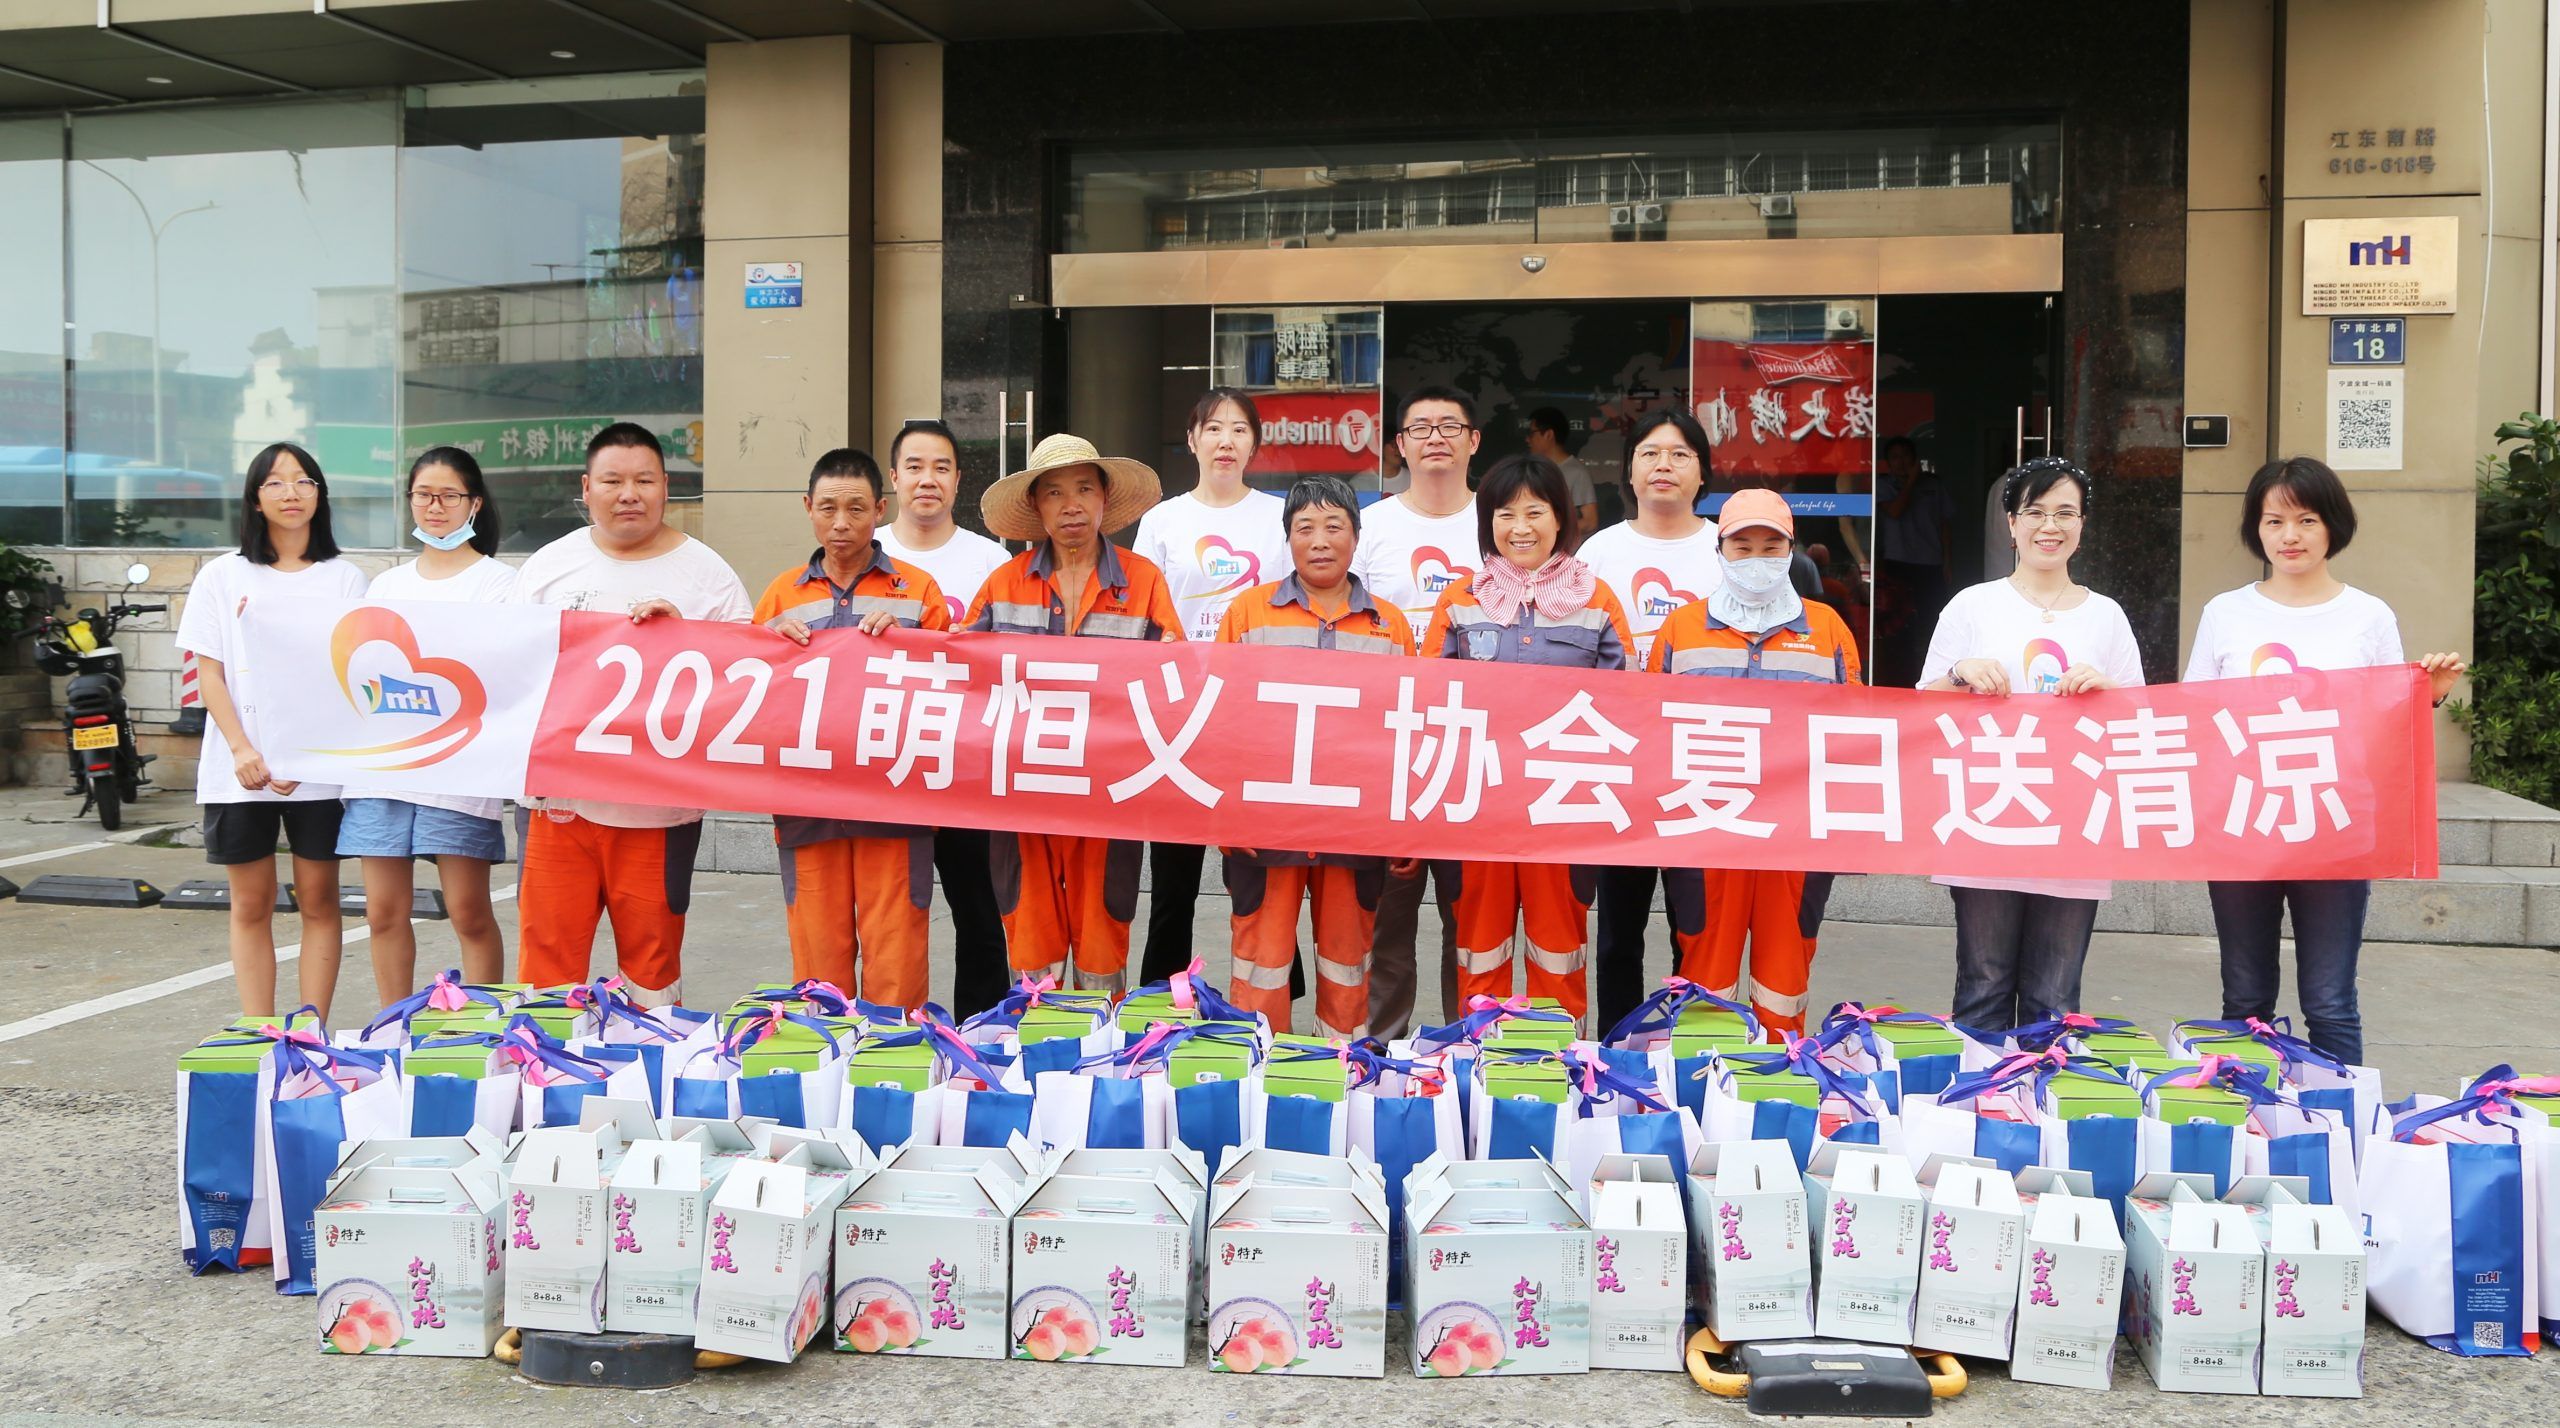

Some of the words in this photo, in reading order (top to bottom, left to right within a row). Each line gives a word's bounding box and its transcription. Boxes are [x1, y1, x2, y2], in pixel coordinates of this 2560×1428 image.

[2330, 127, 2436, 148] 江东南路
[2329, 155, 2436, 174] 616-618号
[2340, 323, 2397, 333] 宁南北路
[2353, 338, 2385, 359] 18
[1822, 501, 1836, 509] life
[575, 643, 2353, 851] 2021萌恒义工协会夏日送清凉
[512, 1189, 540, 1250] 水蜜桃
[613, 1192, 642, 1253] 水蜜桃
[1832, 1196, 1860, 1259] 水蜜桃
[341, 1228, 366, 1241] 特产
[862, 1228, 887, 1241] 特产
[1719, 1201, 1751, 1261] 水蜜桃
[1929, 1210, 1958, 1272] 水蜜桃
[710, 1211, 739, 1274] 水蜜桃
[1040, 1236, 1066, 1249] 特产
[1237, 1247, 1263, 1260] 特产
[1446, 1251, 1471, 1264] 特产
[1596, 1234, 1625, 1292] 水蜜桃
[2030, 1247, 2059, 1307] 水蜜桃
[2172, 1257, 2202, 1316] 水蜜桃
[408, 1256, 446, 1329] 水蜜桃
[533, 1292, 562, 1302] 8+8+8
[928, 1257, 965, 1330] 水蜜桃
[2274, 1258, 2305, 1318] 水蜜桃
[635, 1295, 664, 1305] 8+8+8
[1108, 1265, 1144, 1338] 水蜜桃
[1748, 1302, 1777, 1311] 8+8+8
[1850, 1301, 1879, 1312] 8+8+8
[727, 1316, 756, 1328] 8+8+8
[1306, 1275, 1342, 1349] 水蜜桃
[1513, 1275, 1549, 1349] 水蜜桃
[1946, 1315, 1976, 1326] 8+8+8
[1618, 1334, 1647, 1342] 8+8+8
[2047, 1348, 2077, 1359] 8+8+8
[2193, 1356, 2223, 1365] 8+8+8
[2296, 1359, 2327, 1368] 8+8+8
